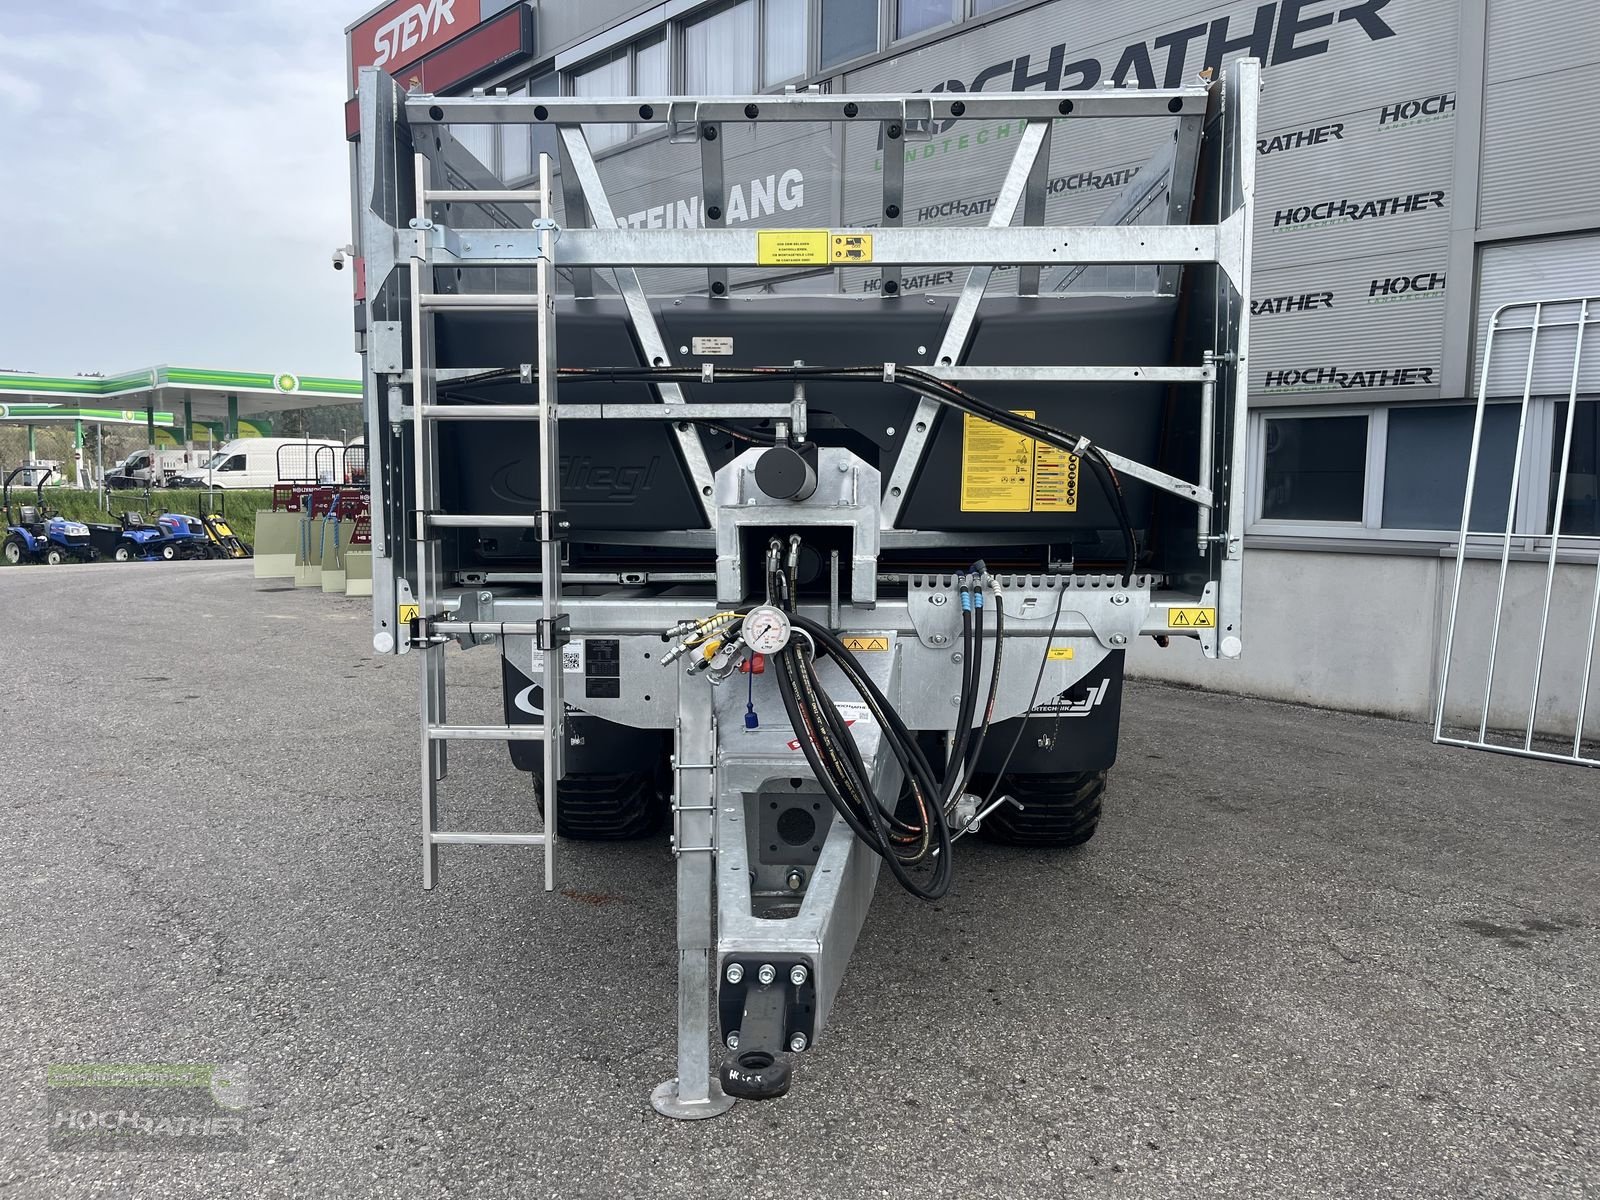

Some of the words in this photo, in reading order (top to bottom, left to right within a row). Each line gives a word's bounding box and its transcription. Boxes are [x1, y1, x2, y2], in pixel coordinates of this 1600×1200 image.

[373, 0, 455, 66] STEYR
[877, 0, 1397, 151] OCHRATHER
[1047, 166, 1142, 194] HOCHRATH
[918, 198, 998, 222] HOCHRATH
[1274, 190, 1445, 226] HOCHRATHER
[864, 271, 954, 292] HORATHER
[1369, 272, 1446, 296] HOCH
[1265, 367, 1433, 388] HOCHRATHER
